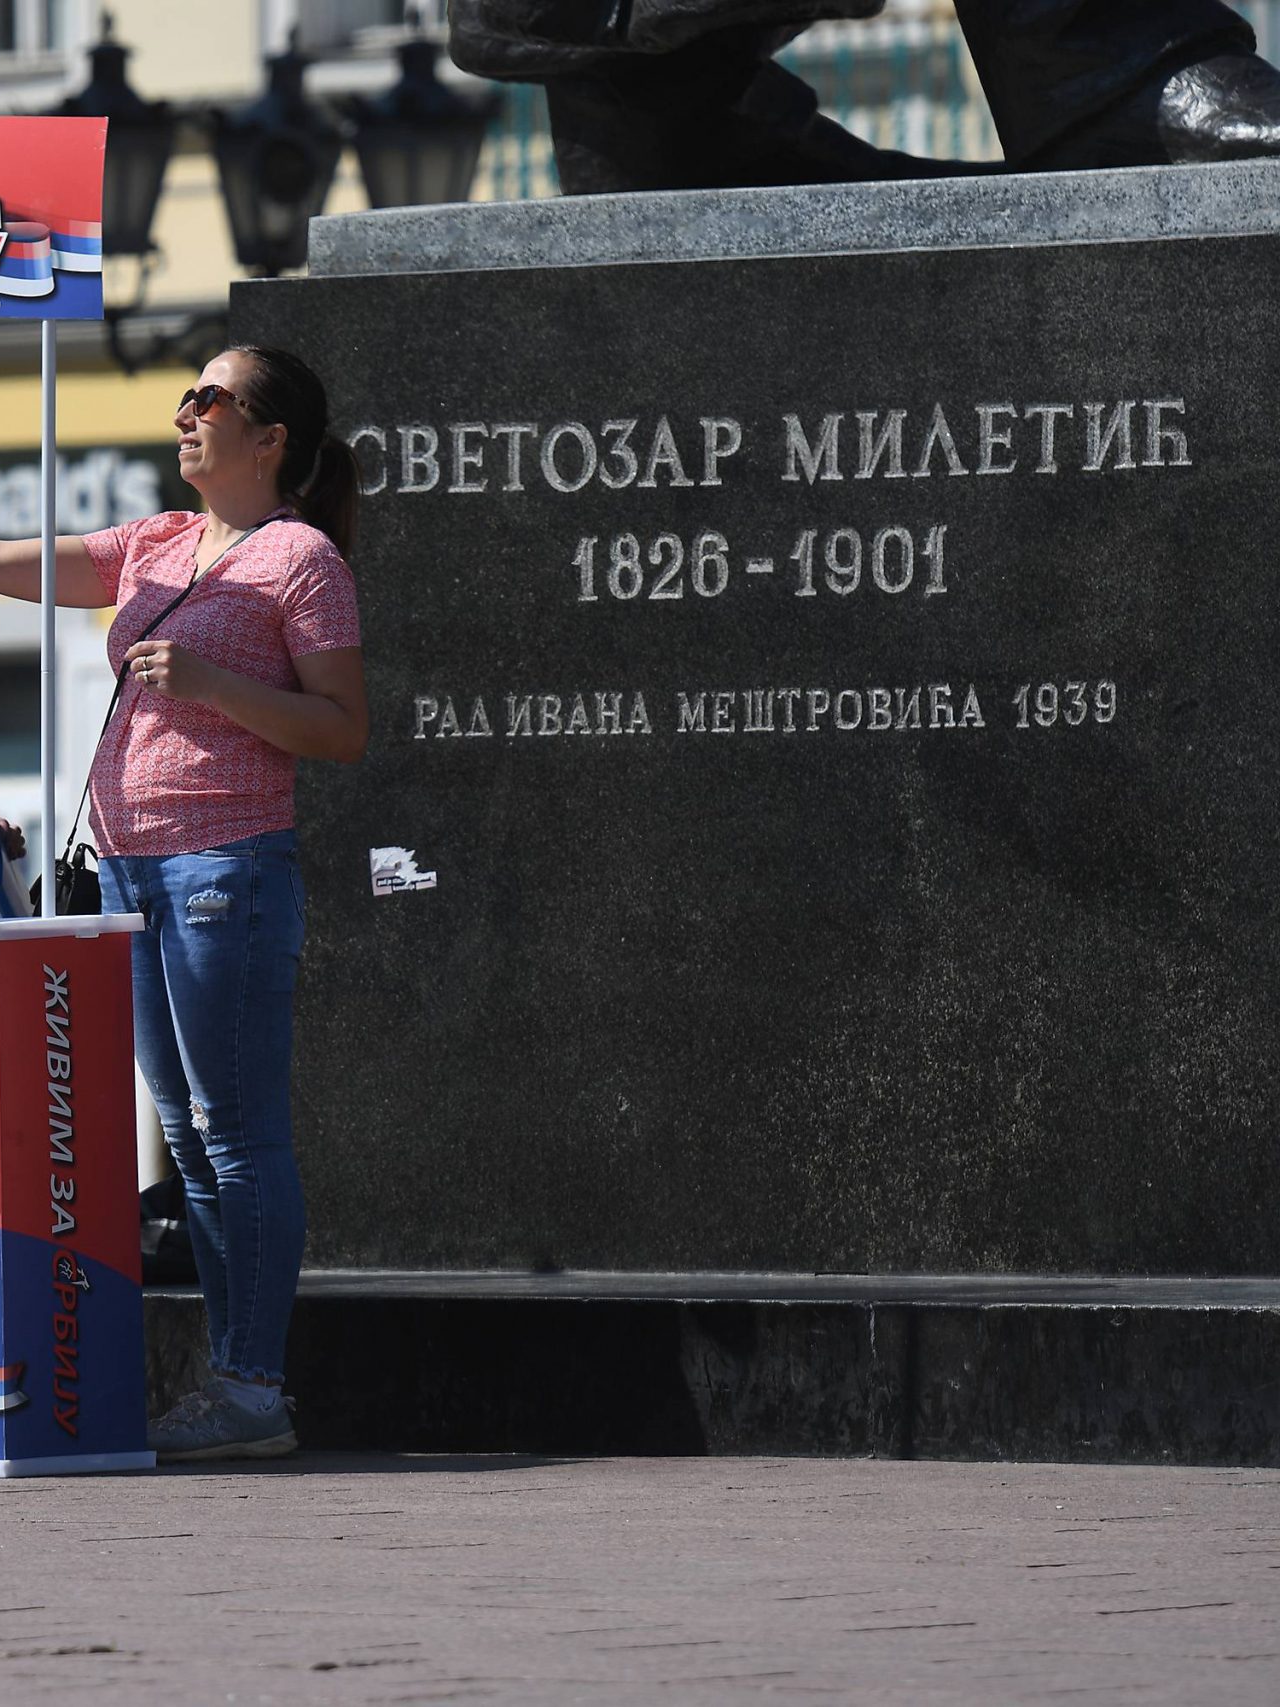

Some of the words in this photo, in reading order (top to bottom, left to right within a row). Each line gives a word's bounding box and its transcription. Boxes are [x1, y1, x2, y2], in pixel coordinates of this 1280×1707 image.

[350, 414, 742, 495] СВЕТОЗАР
[781, 397, 1192, 485] МИЛЕТИЋ
[414, 696, 493, 739] РАД
[505, 691, 652, 737] ИВАНА
[677, 683, 985, 733] МЕШТРОВИЋА
[1012, 679, 1116, 728] 1939
[43, 963, 73, 1163] ЖИВИМ
[50, 1173, 76, 1233] ЗА
[52, 1249, 79, 1437] СРБИЈУ
